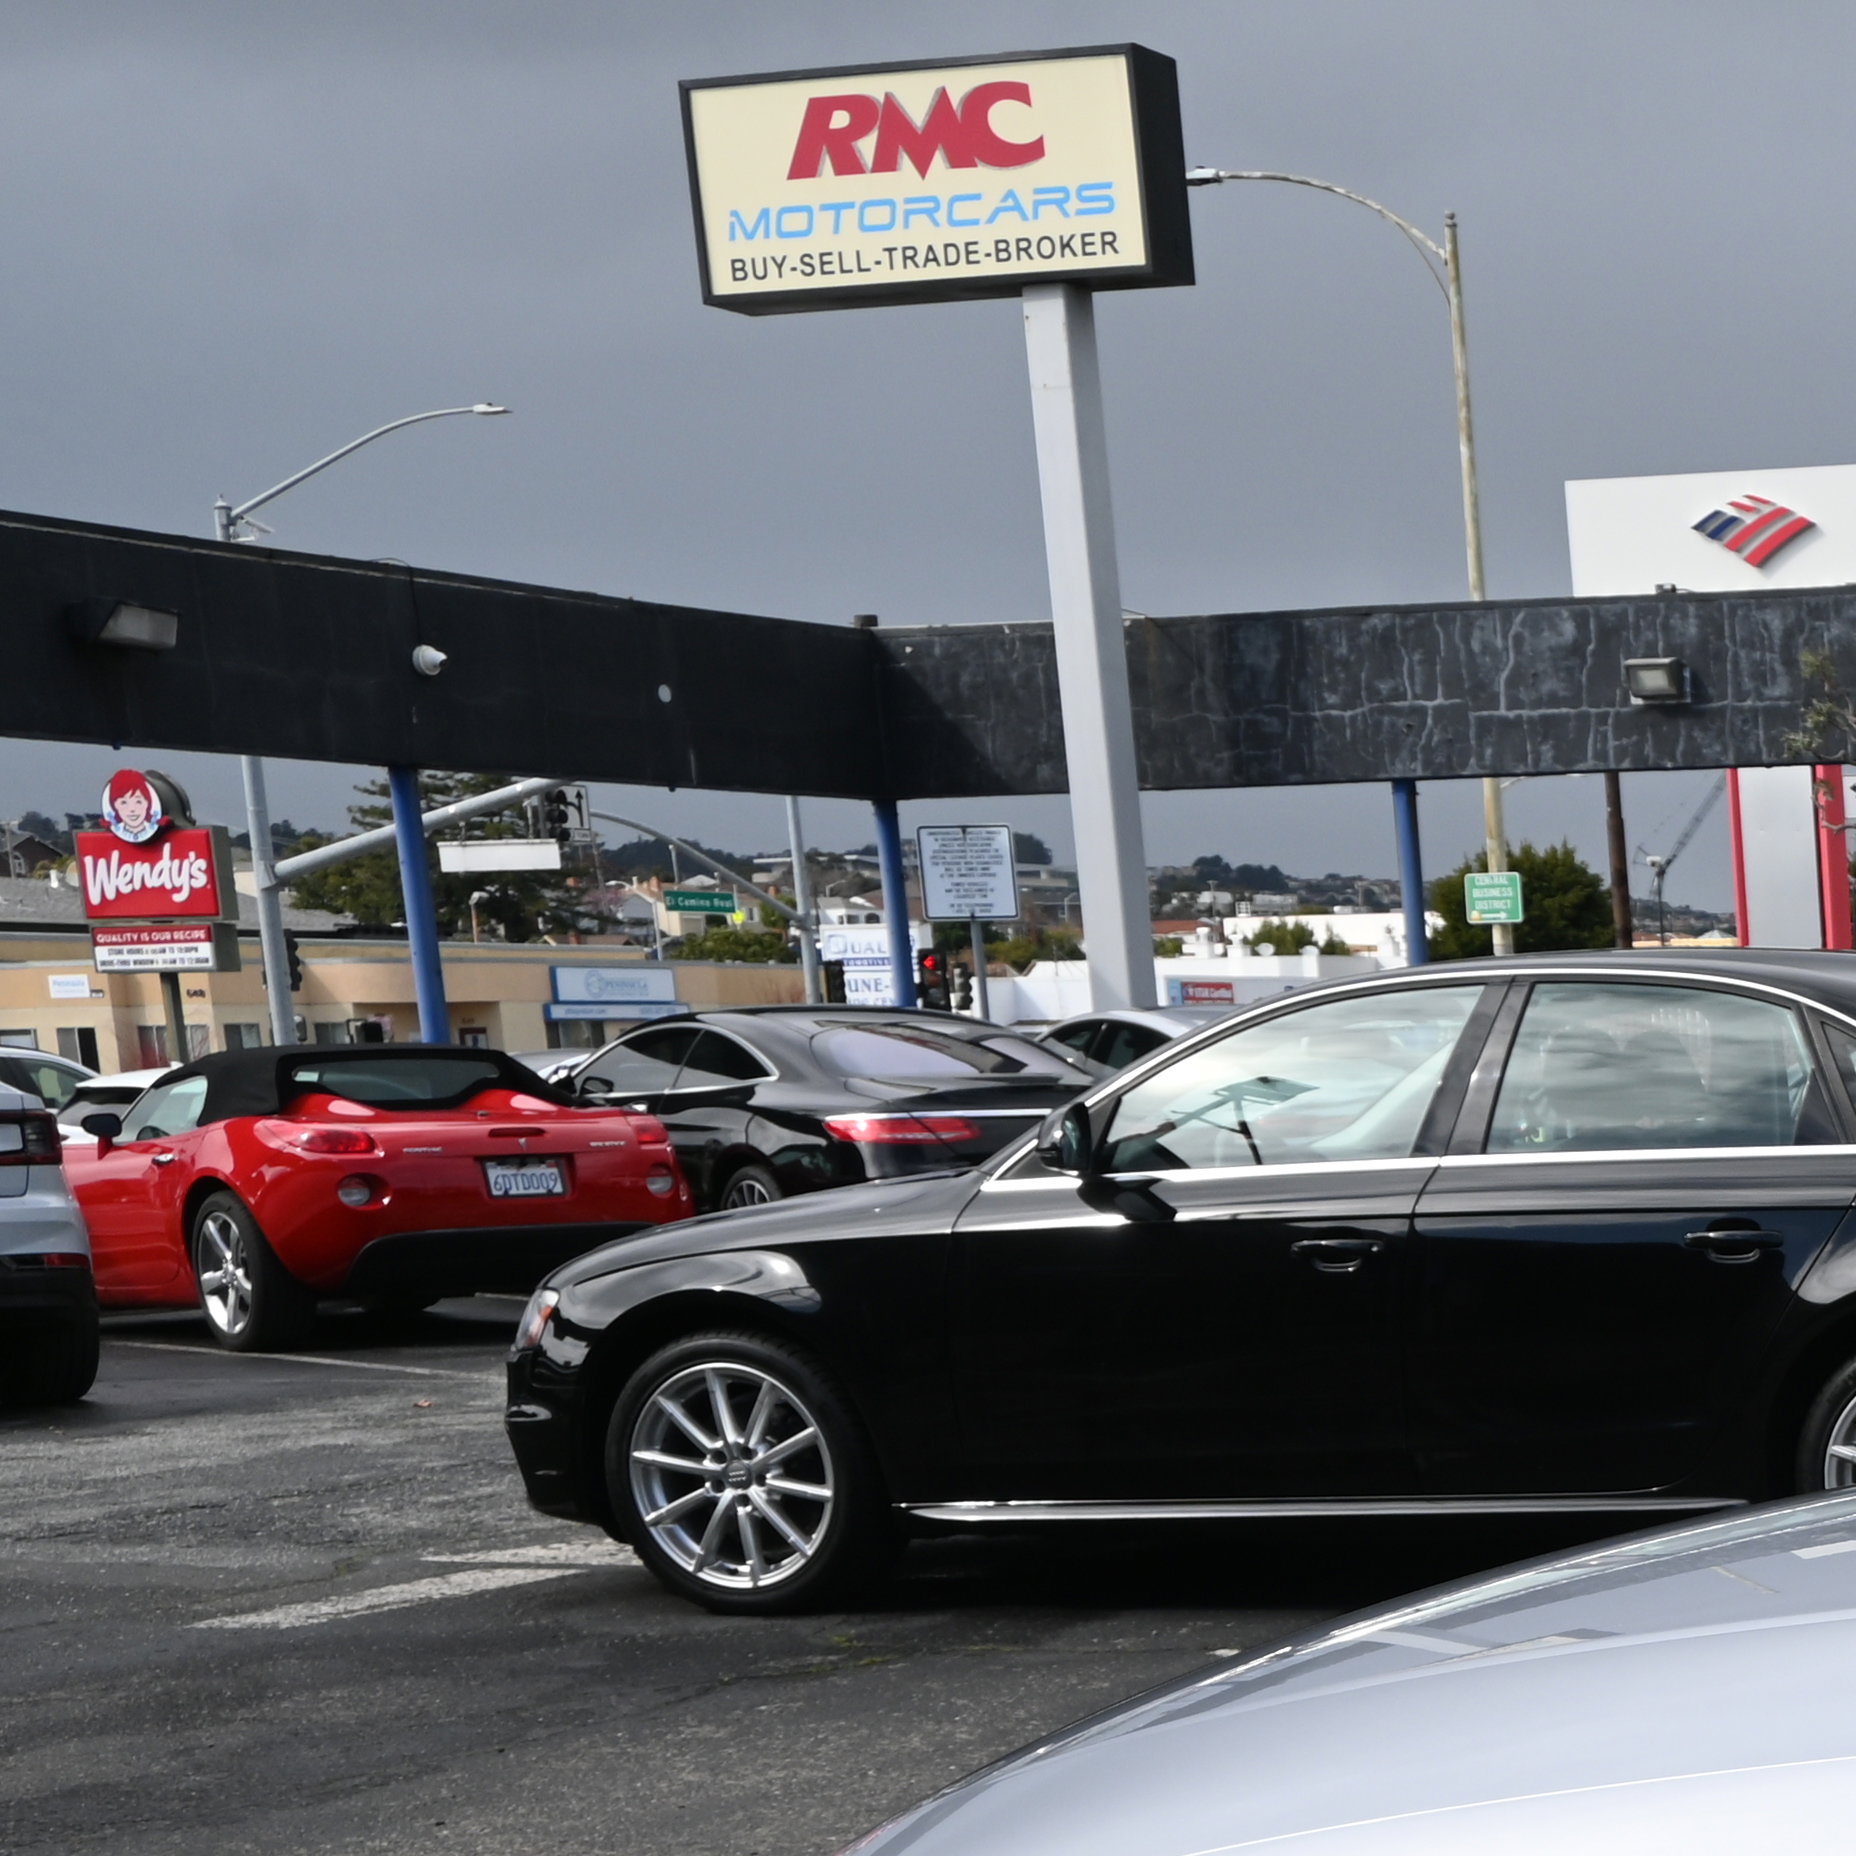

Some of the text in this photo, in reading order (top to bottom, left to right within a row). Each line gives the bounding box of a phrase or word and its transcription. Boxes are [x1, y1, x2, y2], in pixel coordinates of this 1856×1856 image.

[786, 80, 1046, 181] RMC
[728, 181, 1116, 242] MOTORCARS
[730, 230, 1120, 282] BUY-SELL-TRADE-BROKER
[83, 842, 208, 906] Wendy's
[1474, 876, 1509, 886] CENTRAL
[1472, 887, 1513, 898] BUSINESS
[1474, 899, 1511, 910] DISTRICT
[96, 929, 207, 943] QUALITY IS OUR RECIPE
[492, 1172, 559, 1193] 6DTD009
